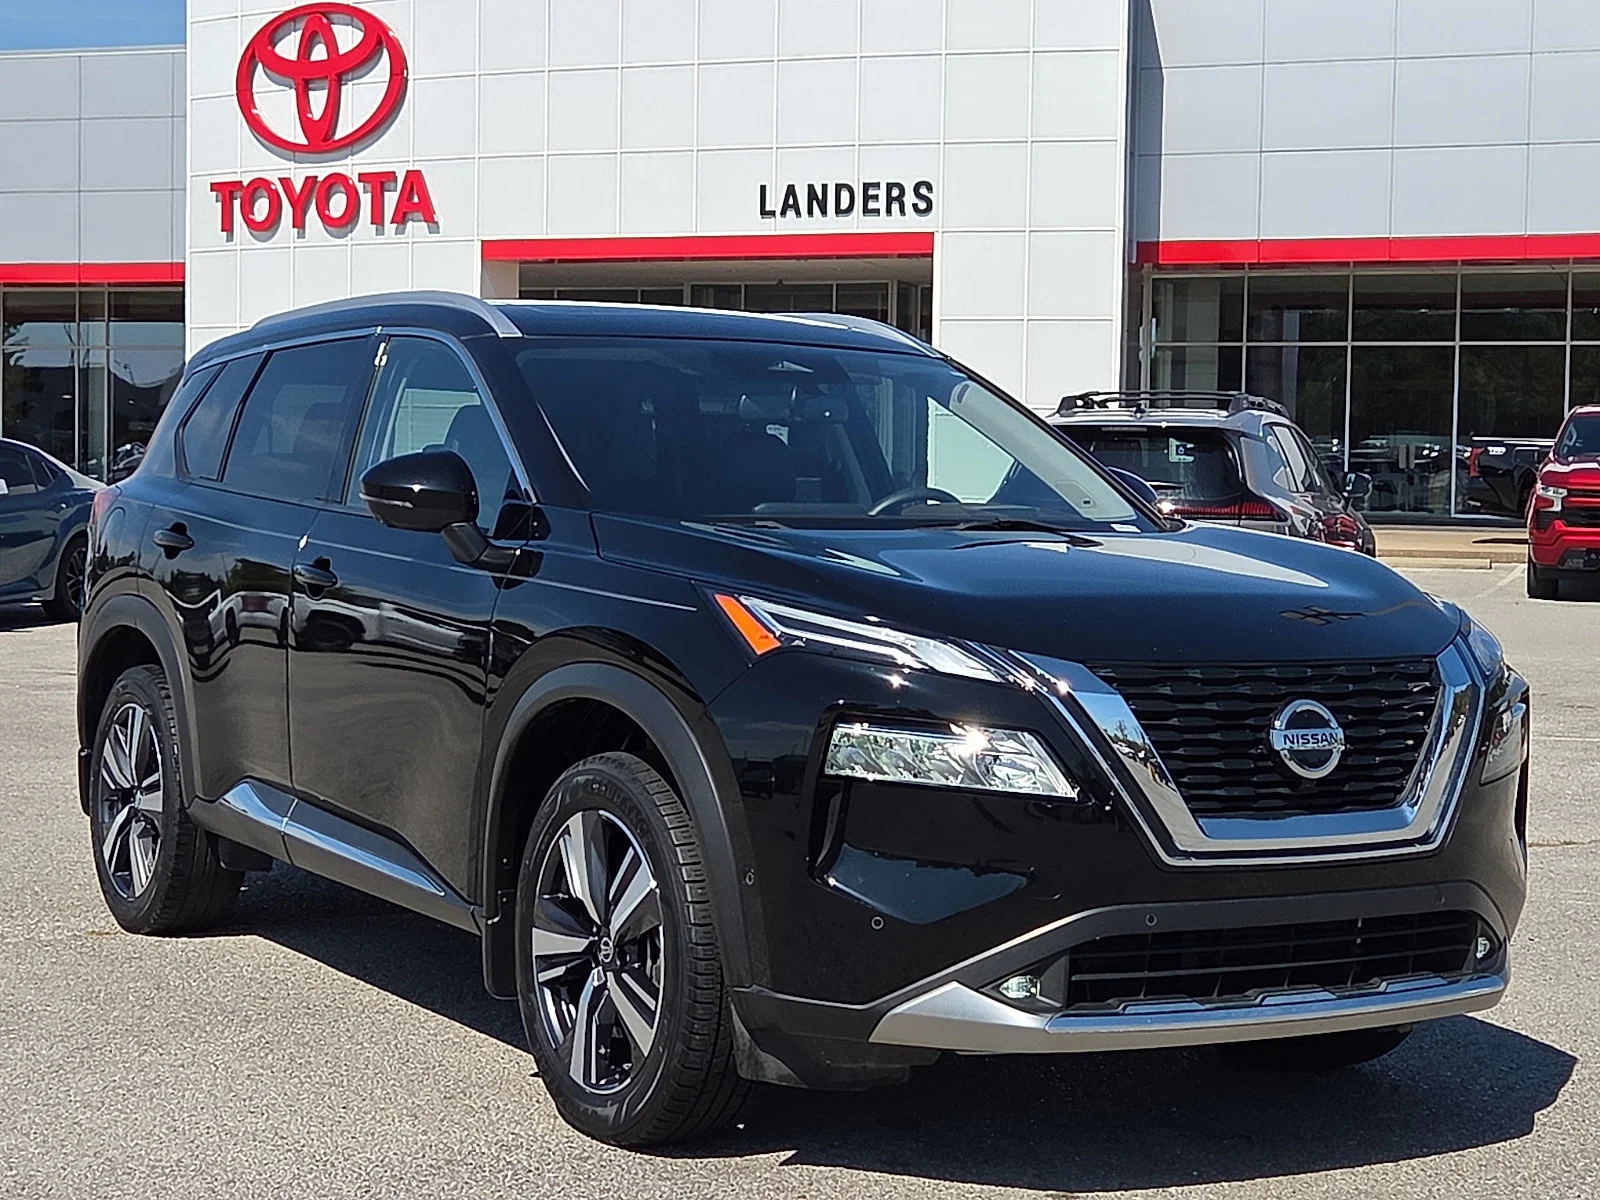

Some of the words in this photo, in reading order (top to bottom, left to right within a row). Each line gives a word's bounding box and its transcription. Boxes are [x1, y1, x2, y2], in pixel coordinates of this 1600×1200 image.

[210, 169, 437, 236] TOYOTA
[759, 180, 934, 218] LANDERS
[1282, 732, 1339, 745] NISSAN
